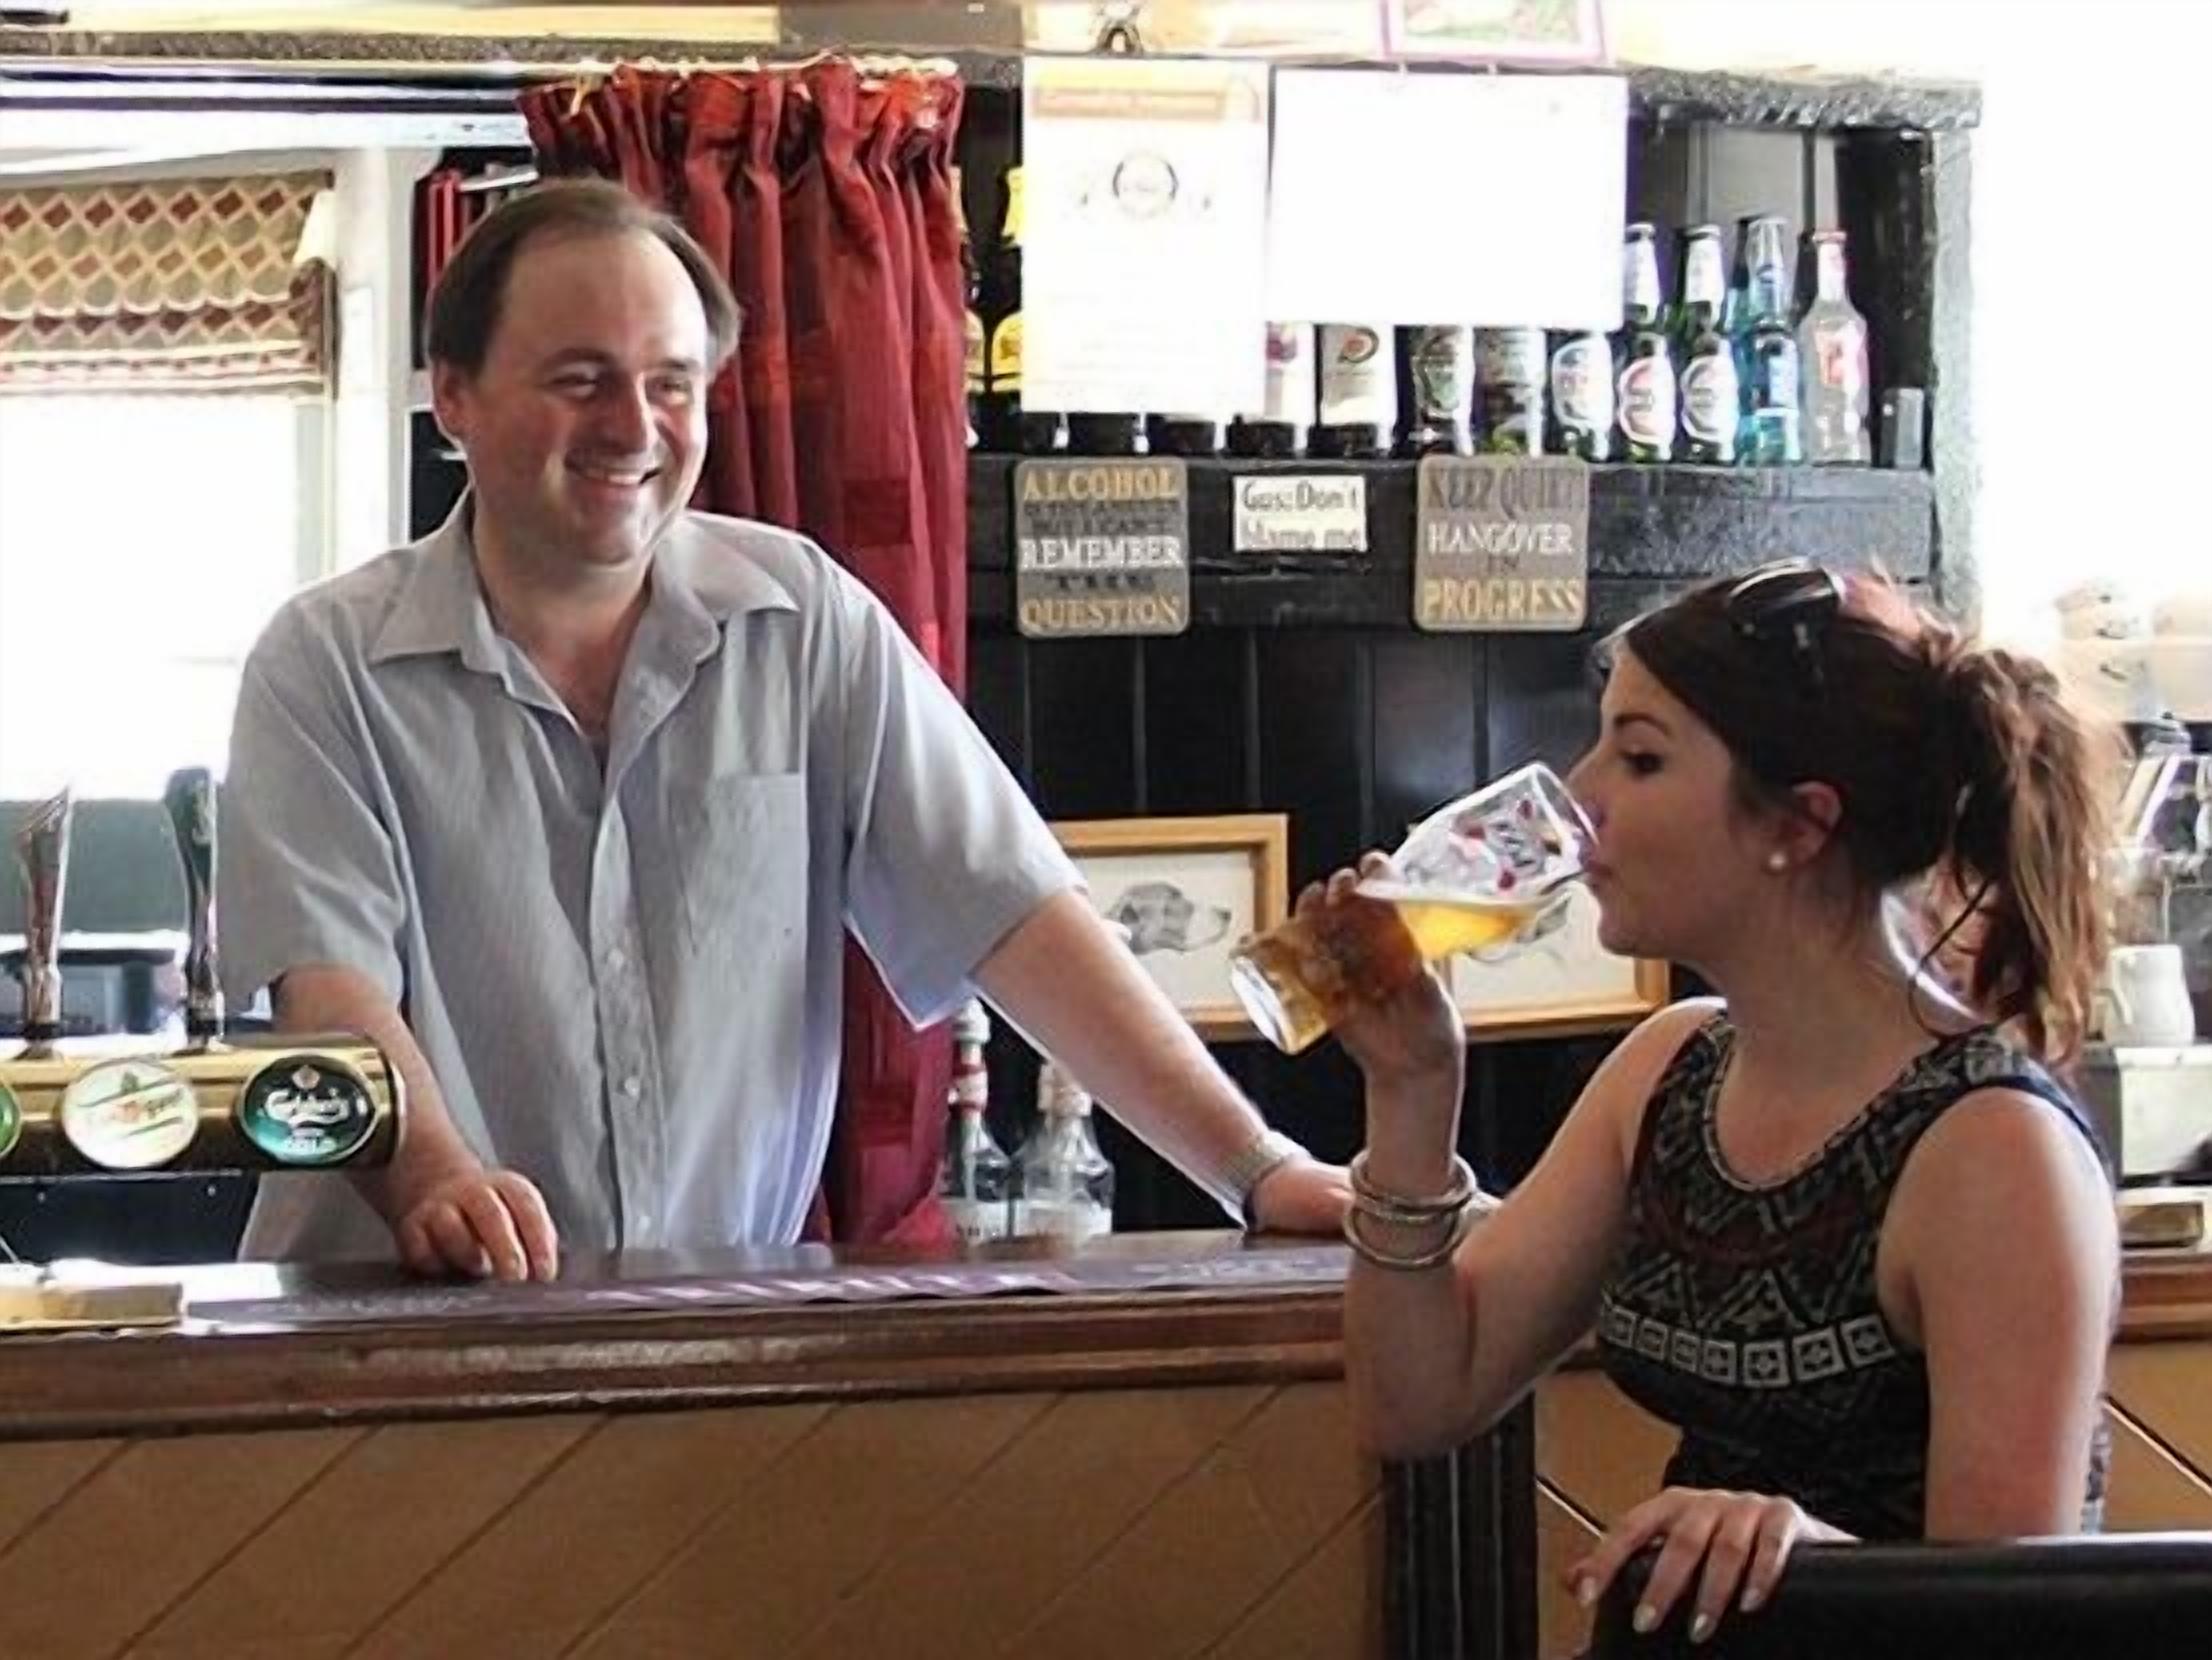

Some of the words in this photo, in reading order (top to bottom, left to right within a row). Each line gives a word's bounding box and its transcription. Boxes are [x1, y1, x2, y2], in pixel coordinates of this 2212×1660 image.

[1023, 467, 1180, 501] ALCOHOL
[1019, 536, 1184, 570] REMEMBER
[1427, 522, 1574, 555] HANGOVER
[1019, 595, 1182, 632] QUESTION
[1422, 577, 1582, 622] PROGRESS
